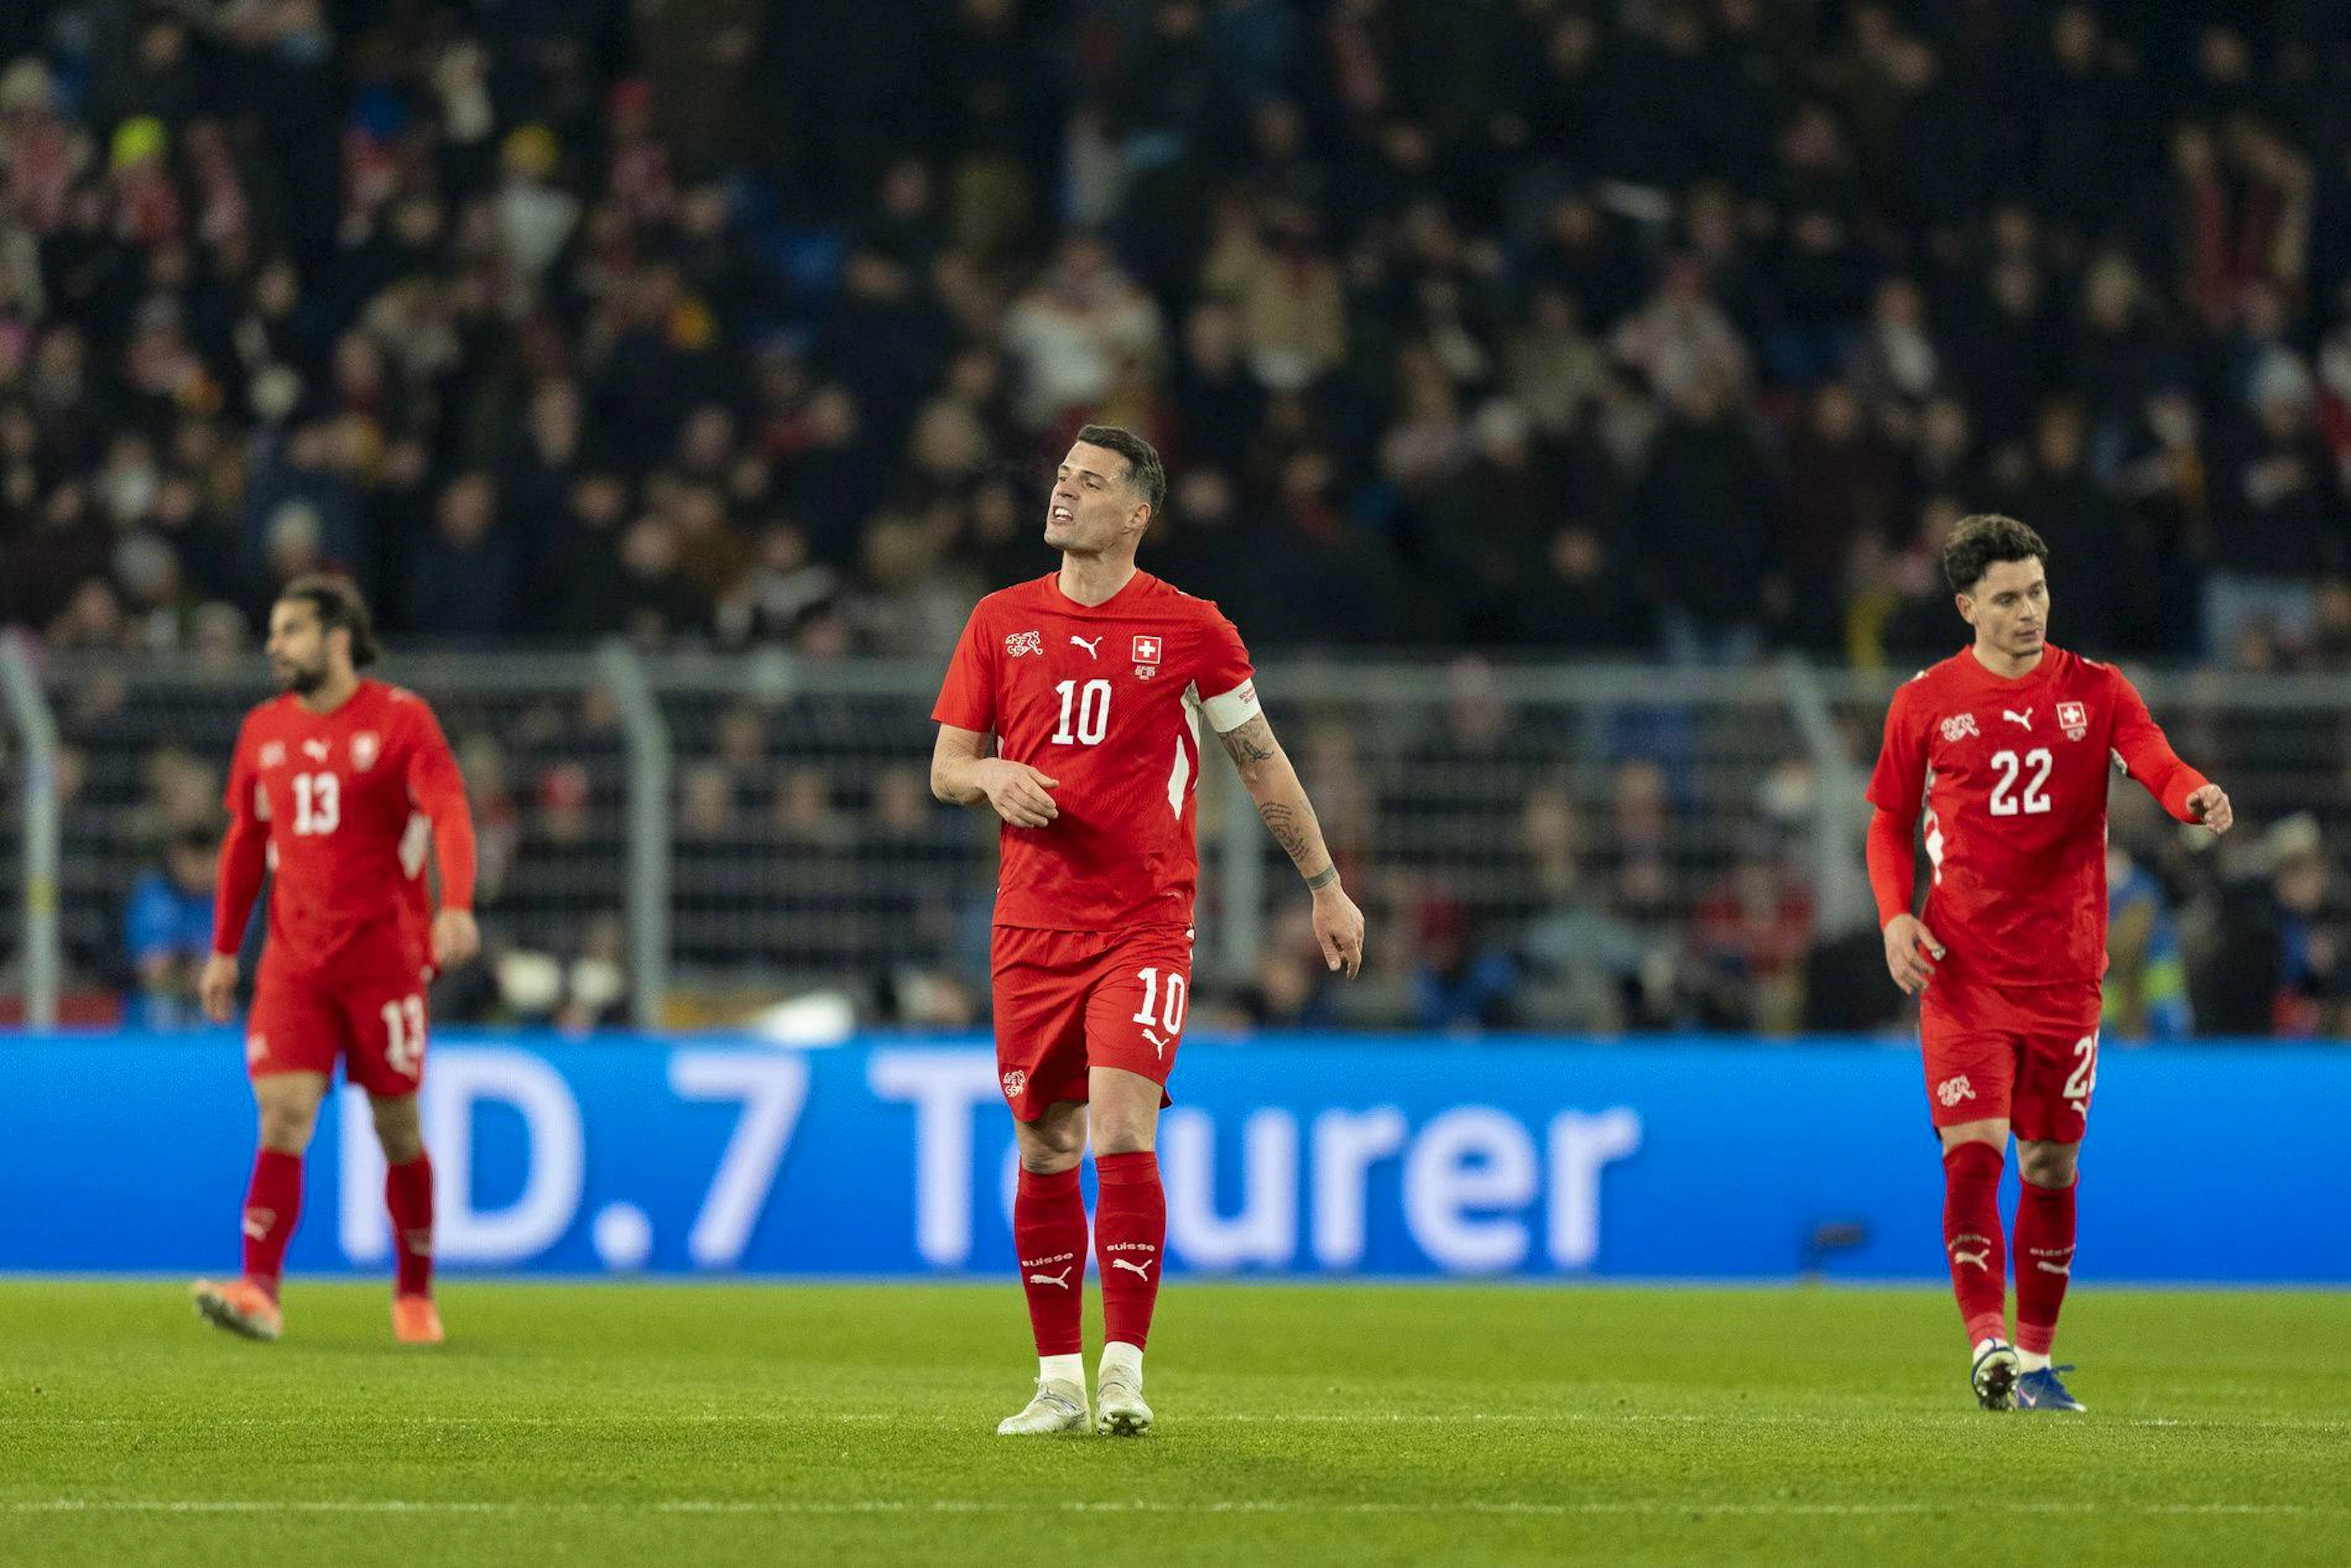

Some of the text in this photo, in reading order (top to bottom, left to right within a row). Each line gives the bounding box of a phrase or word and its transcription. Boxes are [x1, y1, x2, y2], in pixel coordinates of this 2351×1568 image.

[1051, 679, 1112, 745] 10
[291, 771, 340, 836] 13
[1990, 748, 2052, 816] 22
[1133, 967, 1185, 1035] 10
[338, 1046, 1642, 1272] ID.7 Turer
[1022, 1253, 1074, 1267] suisse
[1106, 1242, 1155, 1252] suisse
